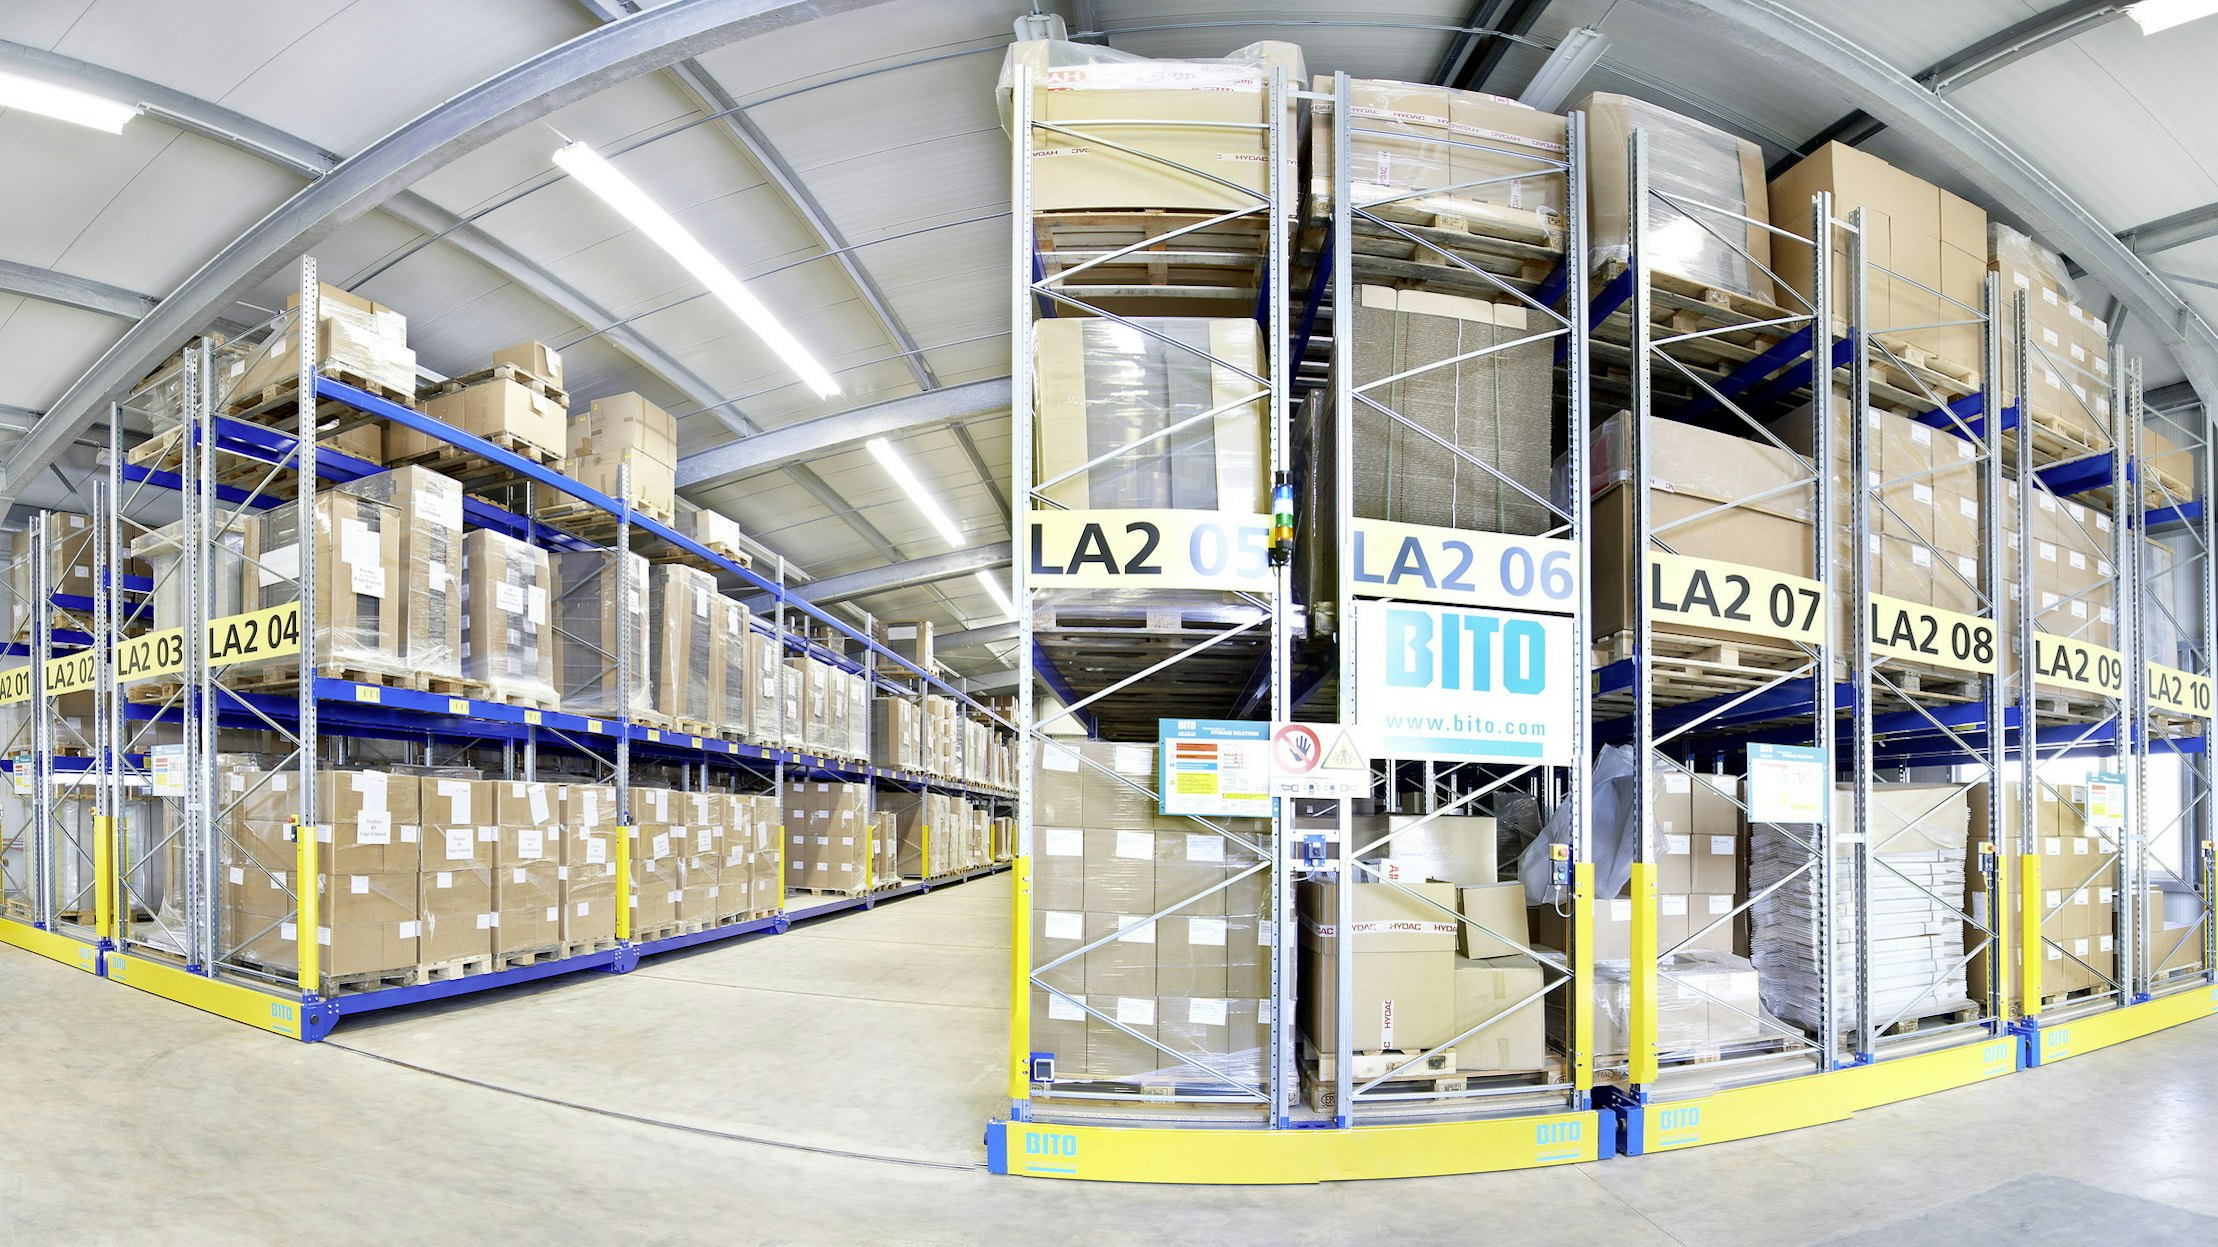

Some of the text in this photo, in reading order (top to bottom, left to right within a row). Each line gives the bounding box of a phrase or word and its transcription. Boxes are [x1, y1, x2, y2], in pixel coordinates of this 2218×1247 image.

[1393, 111, 1425, 121] HYDAC
[1490, 131, 1521, 142] HYDAC
[1235, 154, 1269, 162] HYDAC
[1031, 521, 1270, 579] LA2 05
[1353, 530, 1574, 600] LA2 06
[1652, 562, 1821, 632] LA2 07
[209, 610, 300, 659] LA2 04
[1871, 602, 1994, 664] LA2 08
[117, 634, 183, 676] LA2 03
[1386, 608, 1546, 695] BITO
[46, 654, 95, 691] LA2 02
[2035, 639, 2122, 691] LA2 09
[15, 671, 30, 696] 01
[2148, 668, 2210, 711] LA2 10
[1178, 721, 1196, 731] BITO
[1386, 714, 1546, 736] www.bito.com
[1389, 923, 1422, 932] HYDAC
[271, 1002, 293, 1022] BITO
[1983, 1044, 2008, 1063] BITO
[1660, 1107, 1700, 1130] BITO
[1025, 1132, 1077, 1157] BITO
[1535, 1121, 1581, 1146] BITO
